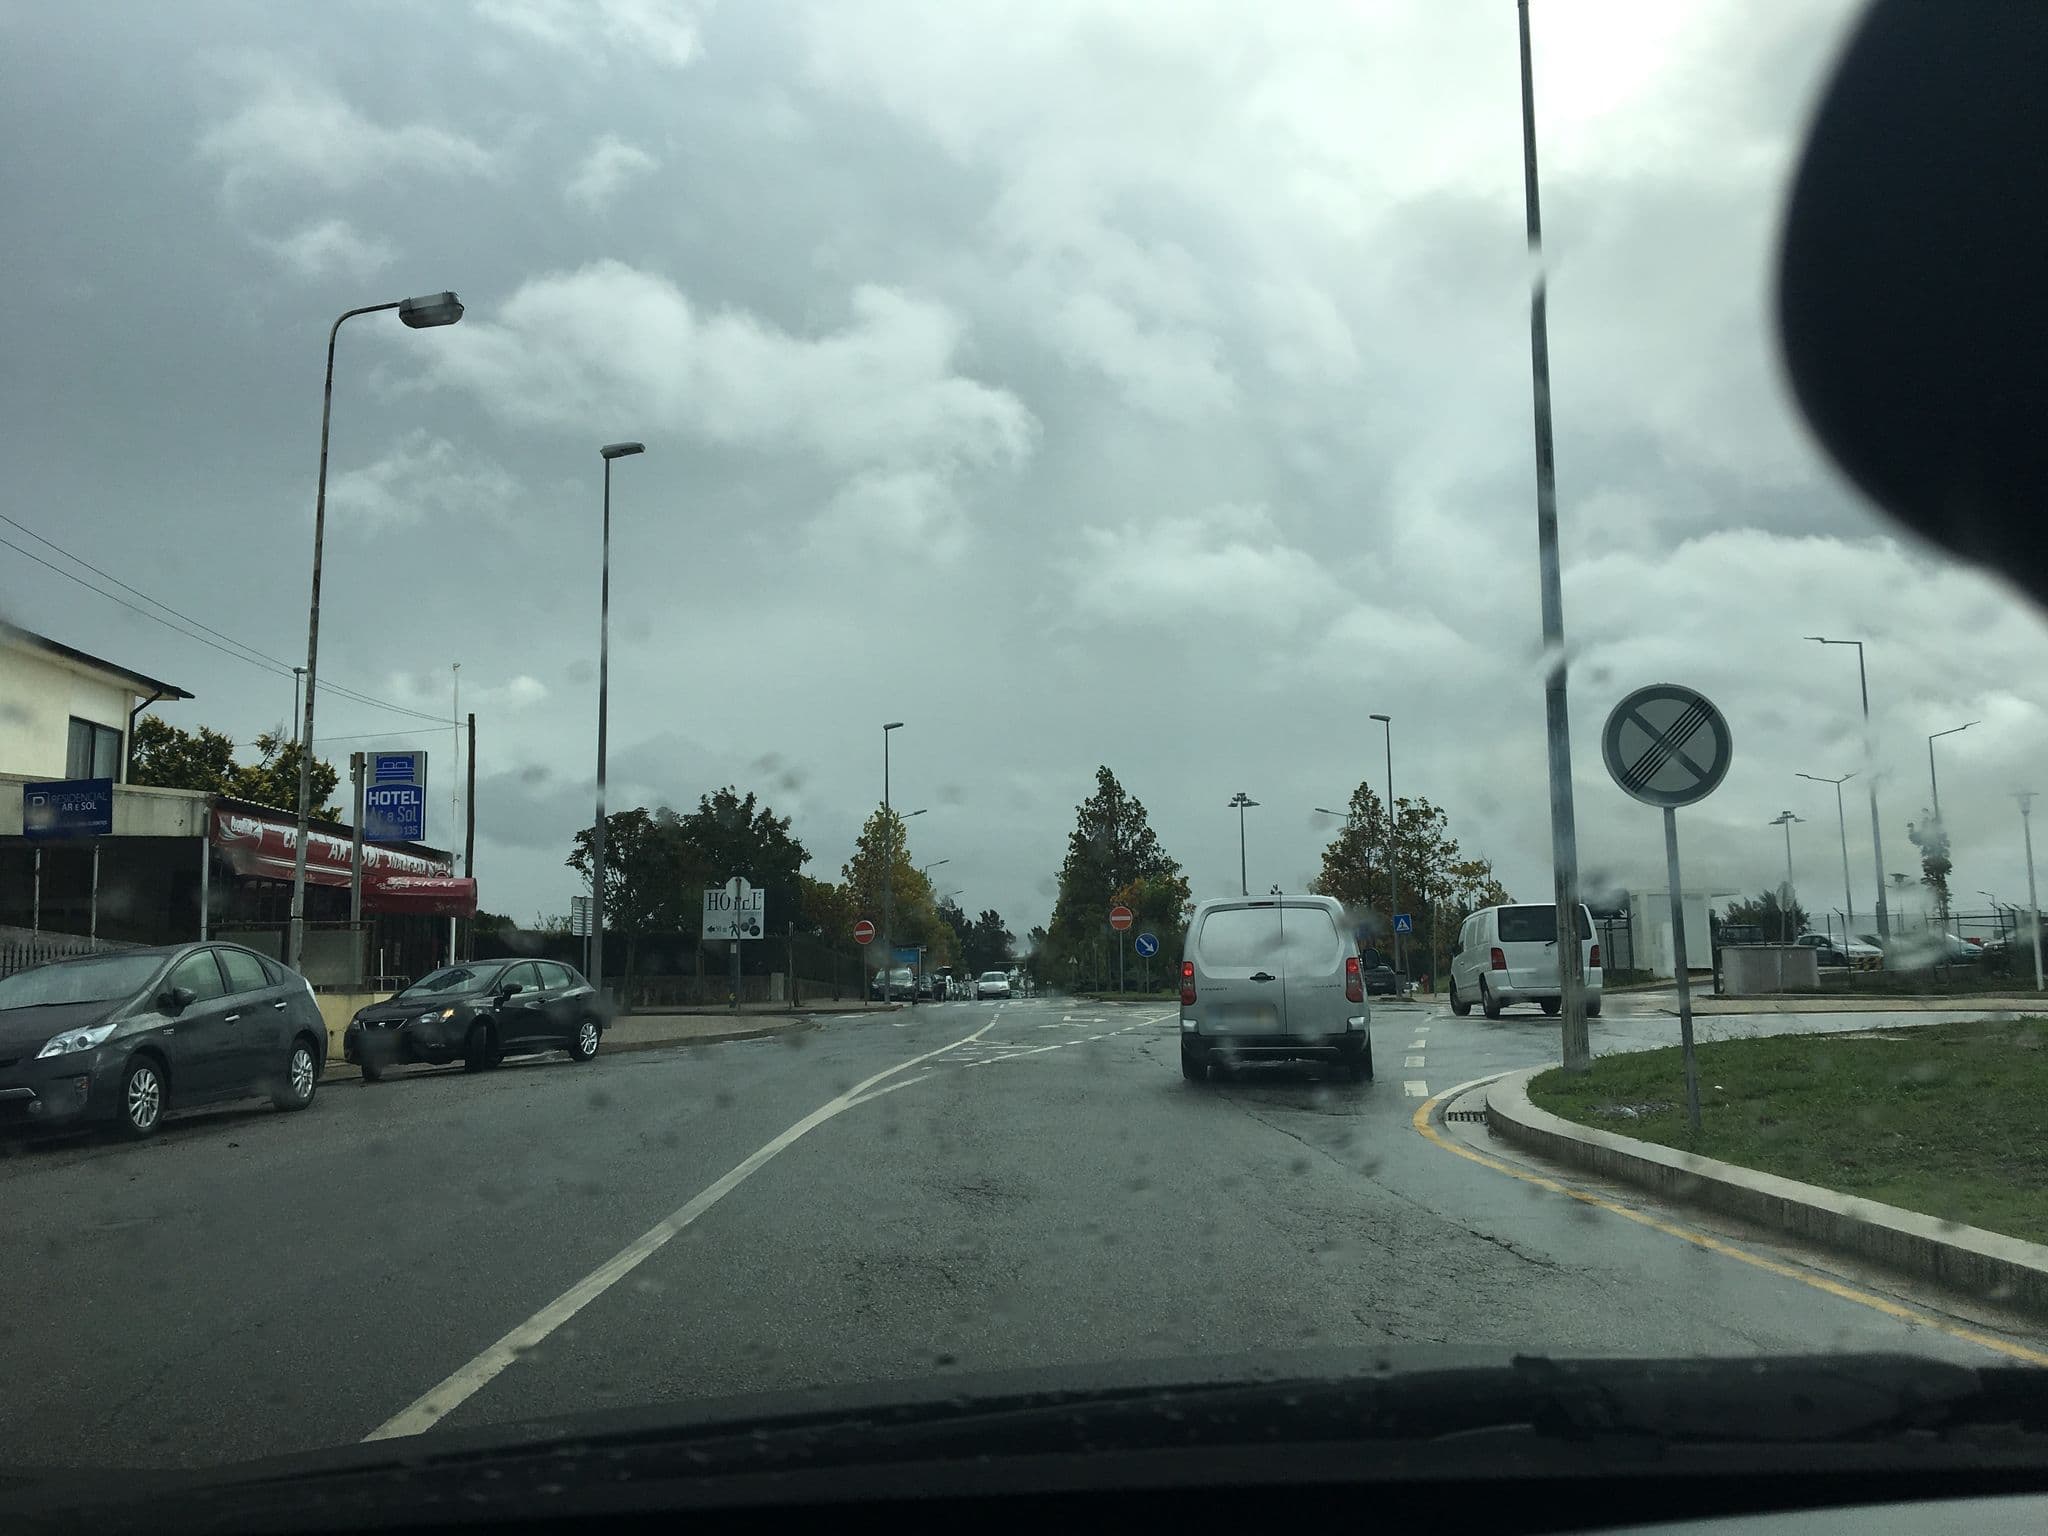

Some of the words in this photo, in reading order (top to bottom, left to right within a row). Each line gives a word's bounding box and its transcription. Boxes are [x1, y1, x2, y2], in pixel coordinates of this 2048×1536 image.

[368, 790, 420, 806] HOTEL
[62, 803, 73, 812] AR
[81, 801, 97, 811] SOL
[397, 806, 417, 822] Sol
